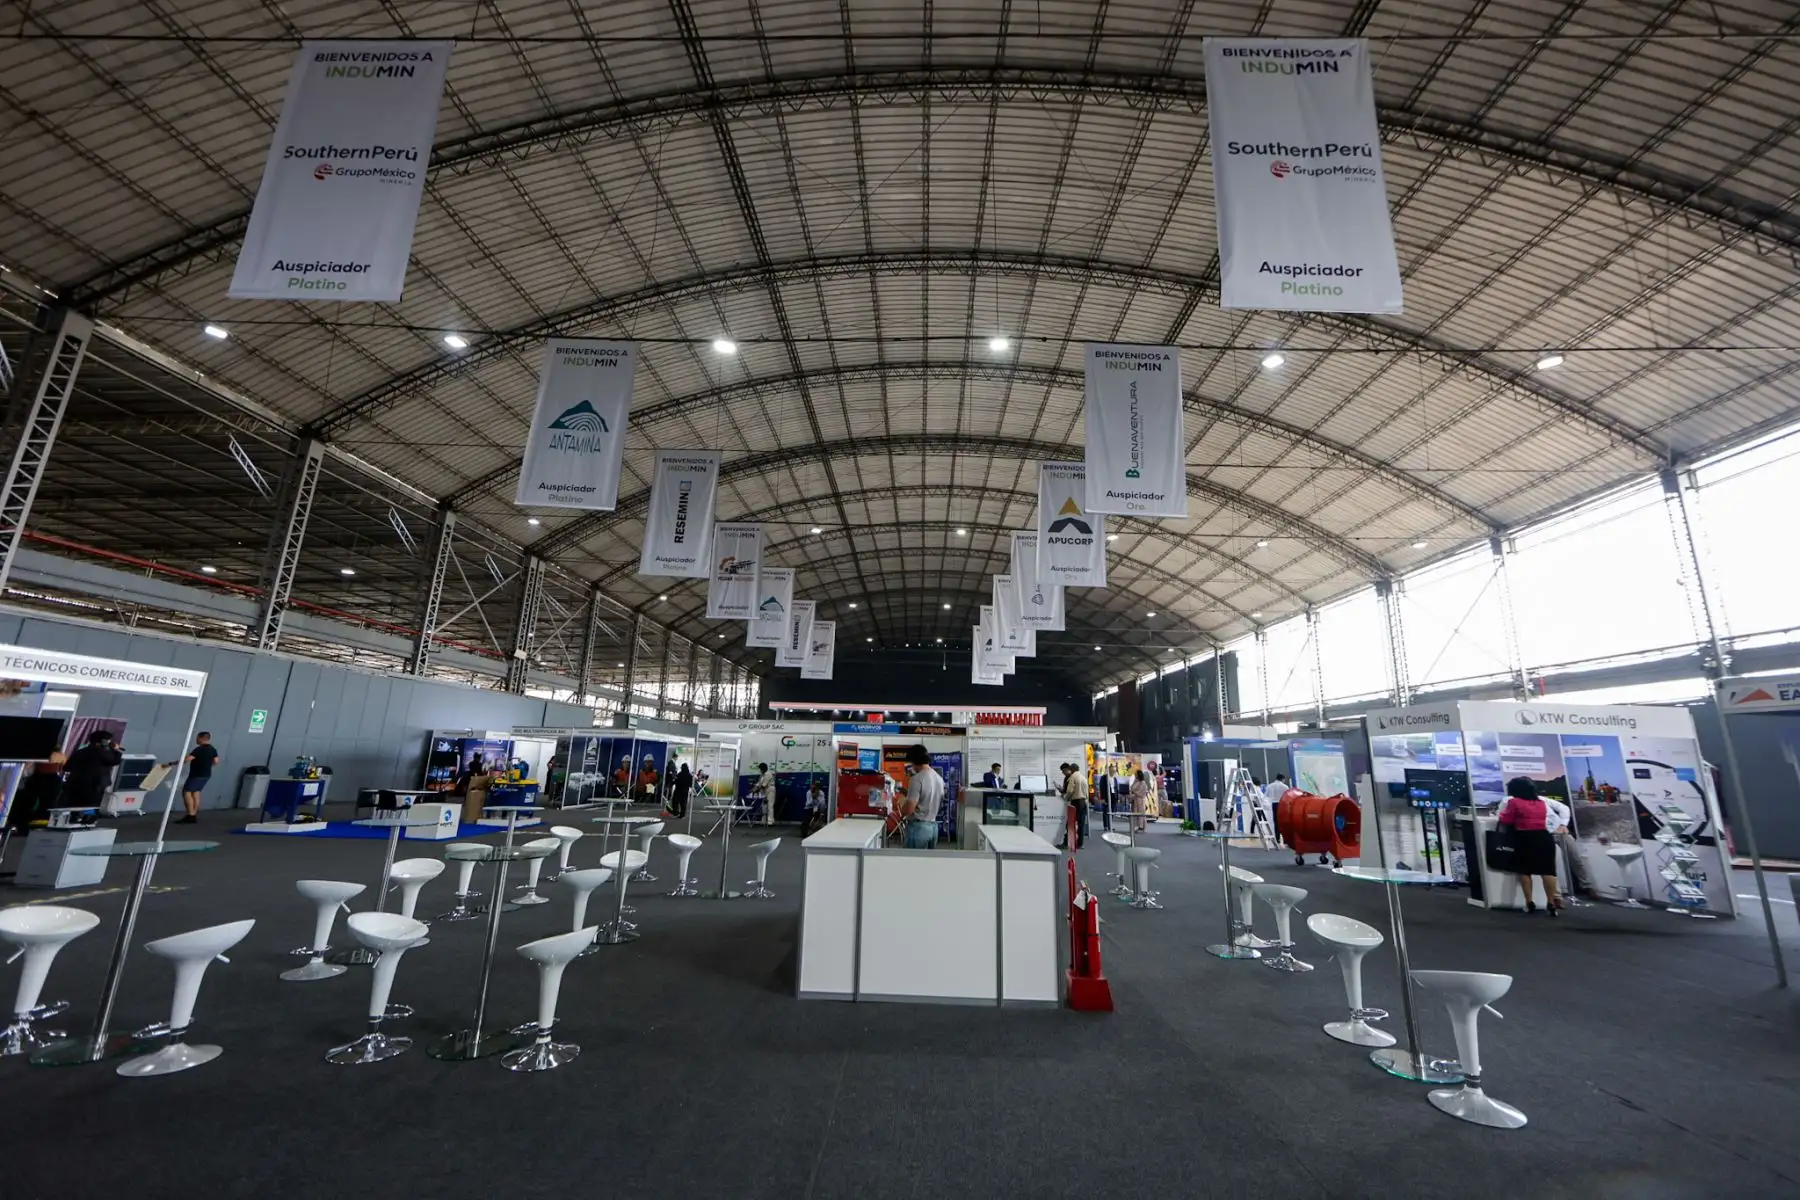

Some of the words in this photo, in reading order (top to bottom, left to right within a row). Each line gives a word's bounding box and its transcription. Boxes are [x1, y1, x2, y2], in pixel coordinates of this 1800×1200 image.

[314, 52, 418, 63] BIENVENIDOS
[421, 52, 433, 62] A
[1222, 47, 1336, 58] BIENVENIDOS
[1339, 50, 1352, 58] A
[325, 65, 415, 78] INDUMIN
[1241, 60, 1339, 75] INDUMIN
[272, 260, 371, 275] Auspiciador
[1259, 261, 1363, 278] Auspiciador
[287, 277, 347, 290] Platino
[1280, 281, 1343, 296] Platino
[556, 347, 619, 357] BIENVENIDOS
[1095, 350, 1161, 360] BIENVENIDOS
[563, 357, 618, 368] INDUMIN
[1105, 361, 1162, 372] INDUMIN
[1125, 380, 1140, 478] BUENAVENTURA
[549, 431, 601, 456] ANTAMINA
[662, 457, 708, 465] BIENVENIDOS
[667, 465, 707, 473] INDUMIN
[538, 482, 596, 493] Auspiciador
[548, 494, 583, 504] Platino
[1106, 490, 1165, 501] Auspiciador
[674, 492, 689, 544] RESEMIN
[1048, 536, 1094, 546] APUCORP
[655, 555, 696, 564] Auspiciador
[1050, 565, 1092, 573] Auspiciador
[80, 665, 168, 686] COMERCIALES
[1406, 712, 1450, 725] Consulting
[1539, 713, 1565, 724] KTW
[1569, 714, 1637, 729] Consulting
